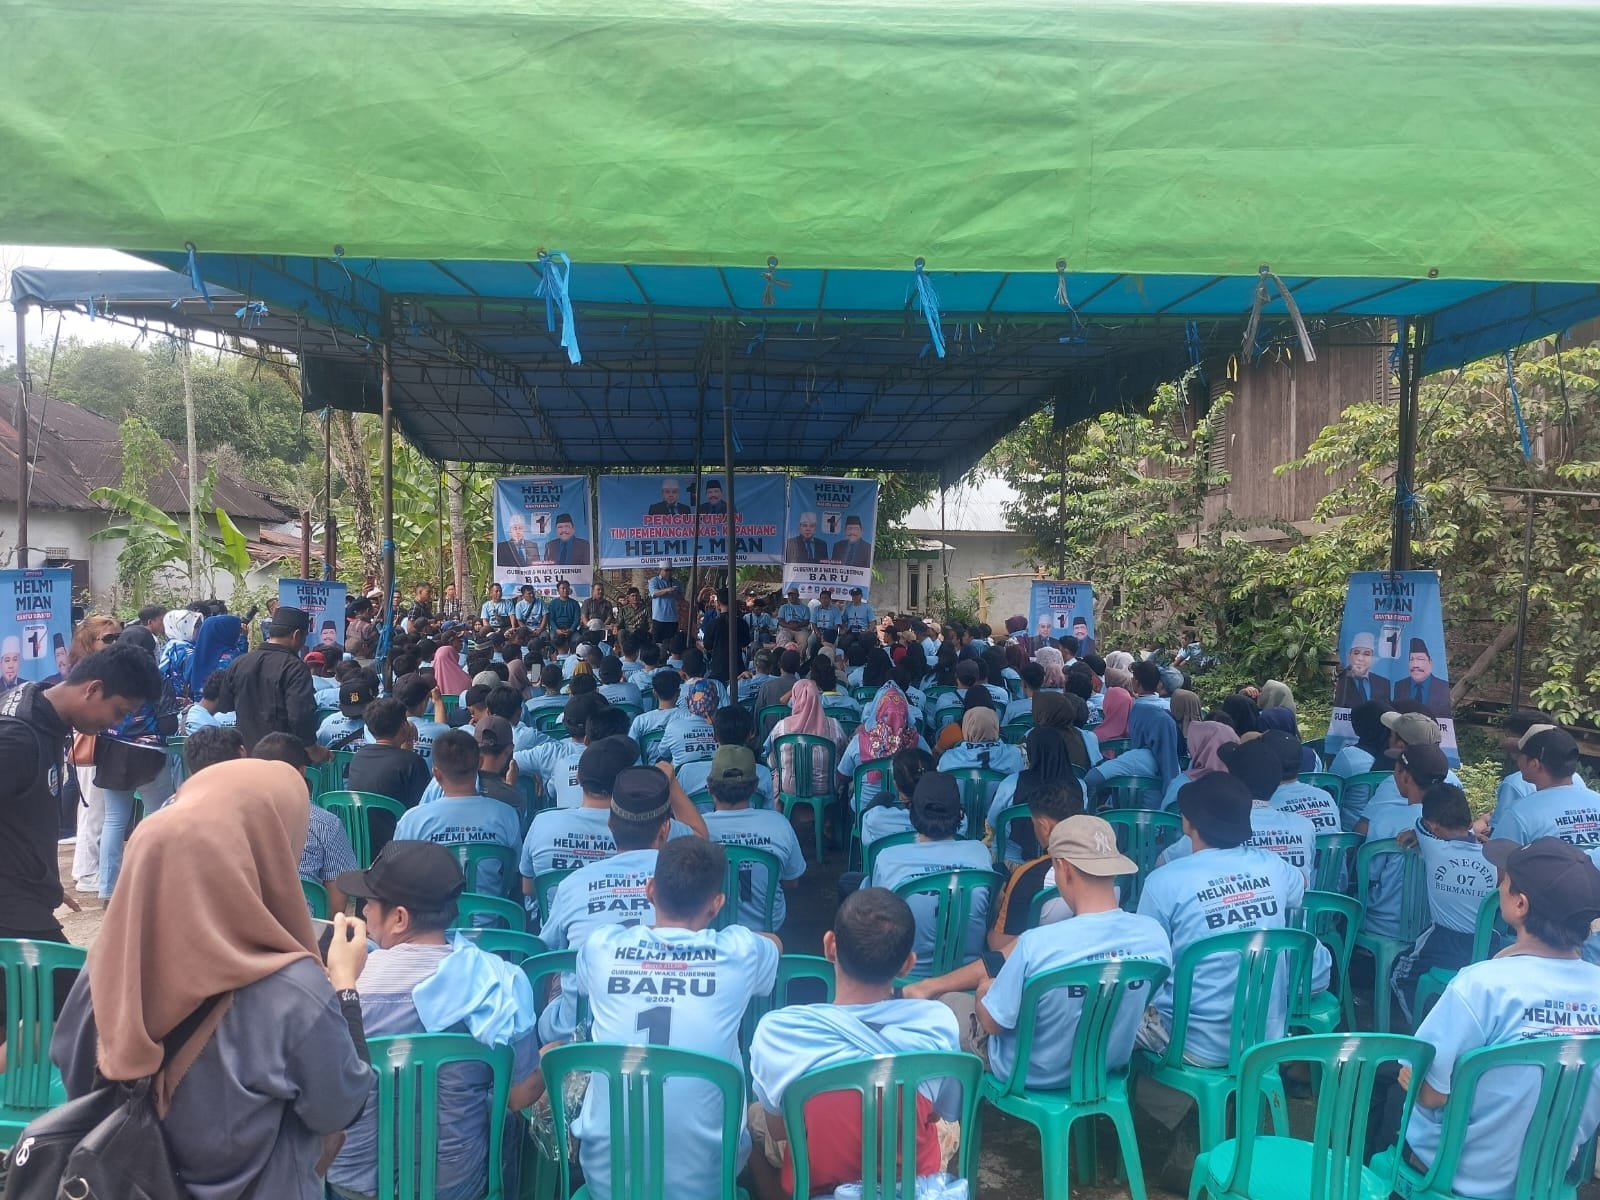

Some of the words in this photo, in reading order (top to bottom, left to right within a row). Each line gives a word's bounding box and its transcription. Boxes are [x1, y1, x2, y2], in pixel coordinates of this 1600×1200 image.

[521, 485, 563, 495] HELMI
[814, 484, 854, 494] HELMI
[524, 495, 561, 504] MIAN
[816, 493, 851, 503] MIAN
[536, 516, 545, 533] 1
[643, 512, 744, 526] PENGUUHAN
[827, 515, 836, 533] 1
[610, 527, 627, 540] TIM
[629, 526, 696, 539] PEMENANGAN
[722, 524, 778, 537] KPAHIANG
[625, 540, 688, 557] HELMI
[709, 537, 763, 554] MAN
[525, 575, 564, 584] BARU
[809, 573, 848, 583] BARU
[13, 579, 53, 594] HELMI
[296, 585, 330, 596] HELMI
[1047, 586, 1077, 596] HELMI
[1371, 582, 1415, 597] HELMI
[15, 596, 52, 611] MIAN
[299, 595, 327, 605] MIAN
[1048, 596, 1076, 604] MIAN
[1374, 597, 1413, 613] MIAN
[1057, 614, 1065, 628] 1
[28, 632, 38, 657] 1
[1386, 631, 1398, 658] 1
[685, 743, 719, 753] BAR
[1308, 800, 1331, 810] MIAN
[1312, 816, 1337, 828] RU
[1554, 815, 1584, 826] HELMI
[430, 832, 465, 842] HELMI
[468, 832, 497, 841] MIAN
[744, 836, 771, 846] MIAN
[1275, 835, 1303, 846] MIAN
[1560, 832, 1600, 845] BAR
[553, 838, 589, 850] HELMI
[593, 841, 617, 851] MIA
[1434, 865, 1447, 882] SD
[1448, 858, 1494, 889] NEGERI
[588, 879, 631, 892] HELMI
[1456, 874, 1476, 887] 07
[1196, 883, 1236, 902] HELMI
[1236, 876, 1271, 893] MIAN
[587, 898, 651, 915] BAR
[1205, 900, 1278, 930] BARU
[615, 946, 666, 961] HELMI
[672, 948, 717, 961] MIAN
[607, 976, 716, 997] BARU
[1521, 1007, 1571, 1026] HELMI
[636, 1005, 672, 1047] 1
